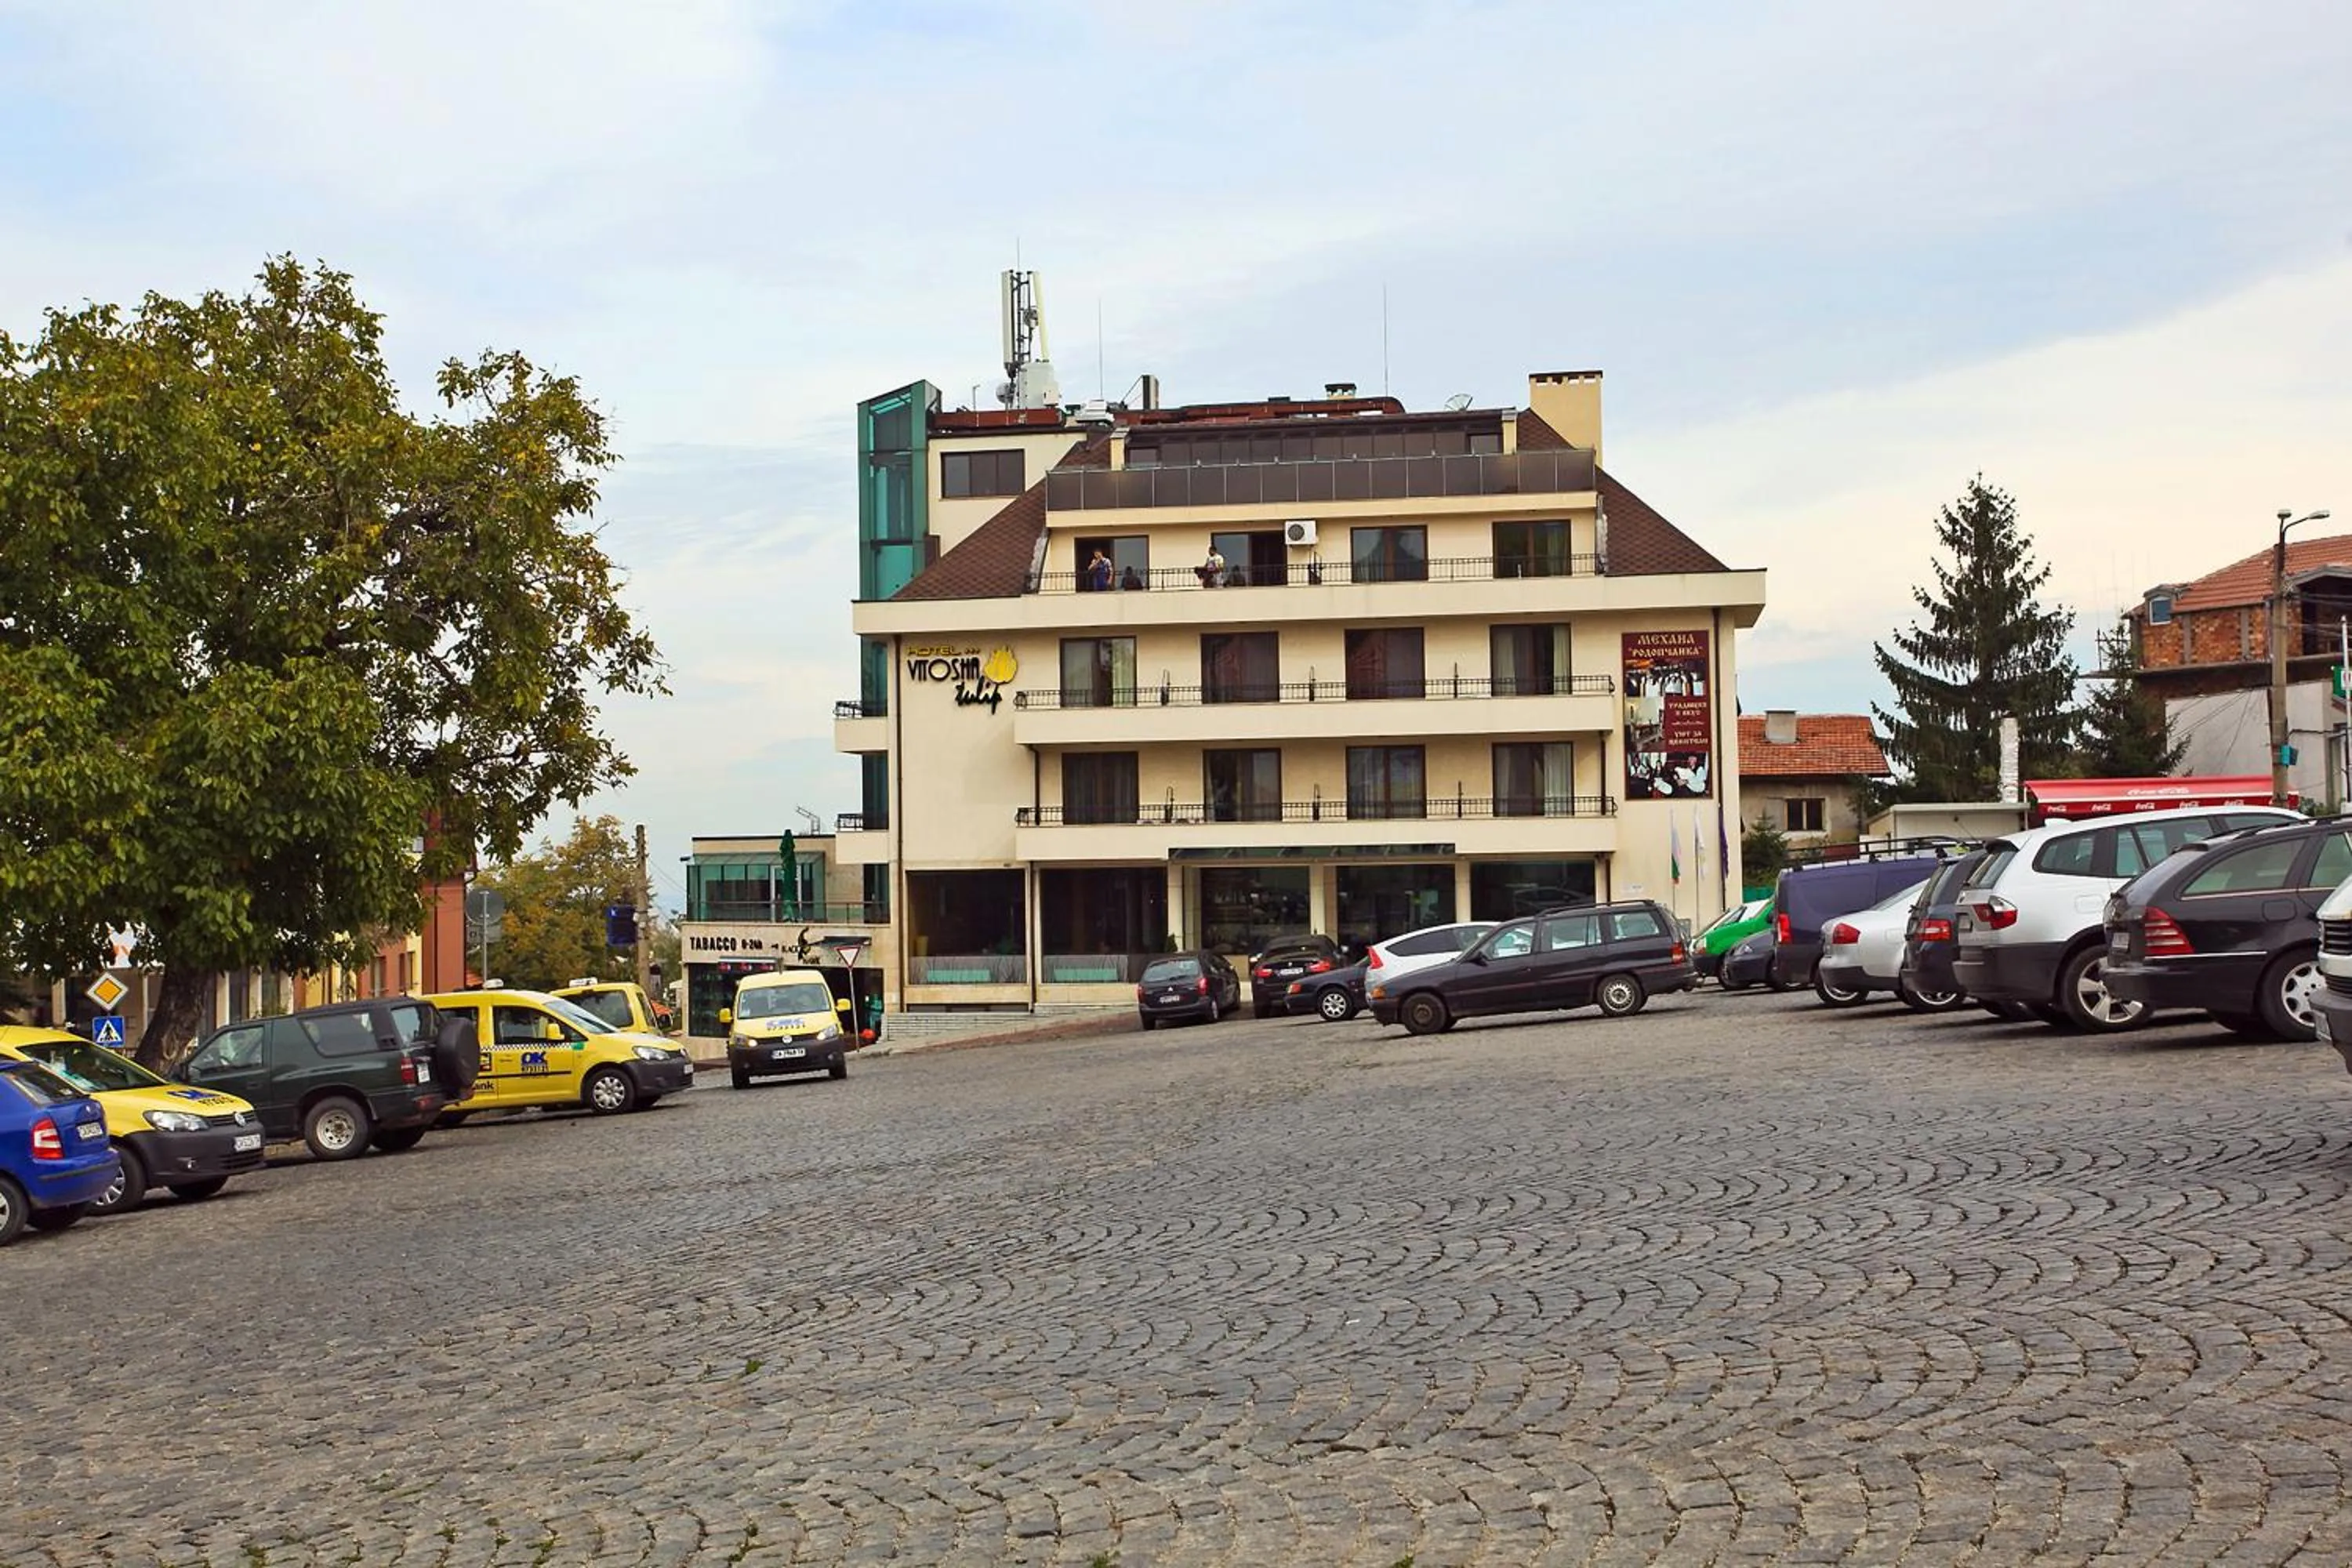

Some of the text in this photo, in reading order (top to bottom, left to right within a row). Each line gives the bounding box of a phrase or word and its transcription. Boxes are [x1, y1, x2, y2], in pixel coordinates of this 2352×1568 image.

[1638, 633, 1695, 644] МЕХАНА
[907, 644, 960, 655] HOTEL
[907, 657, 980, 681] VITOSHA
[955, 675, 1003, 715] tulip
[689, 937, 737, 951] TABACCO
[473, 1081, 494, 1091] ank
